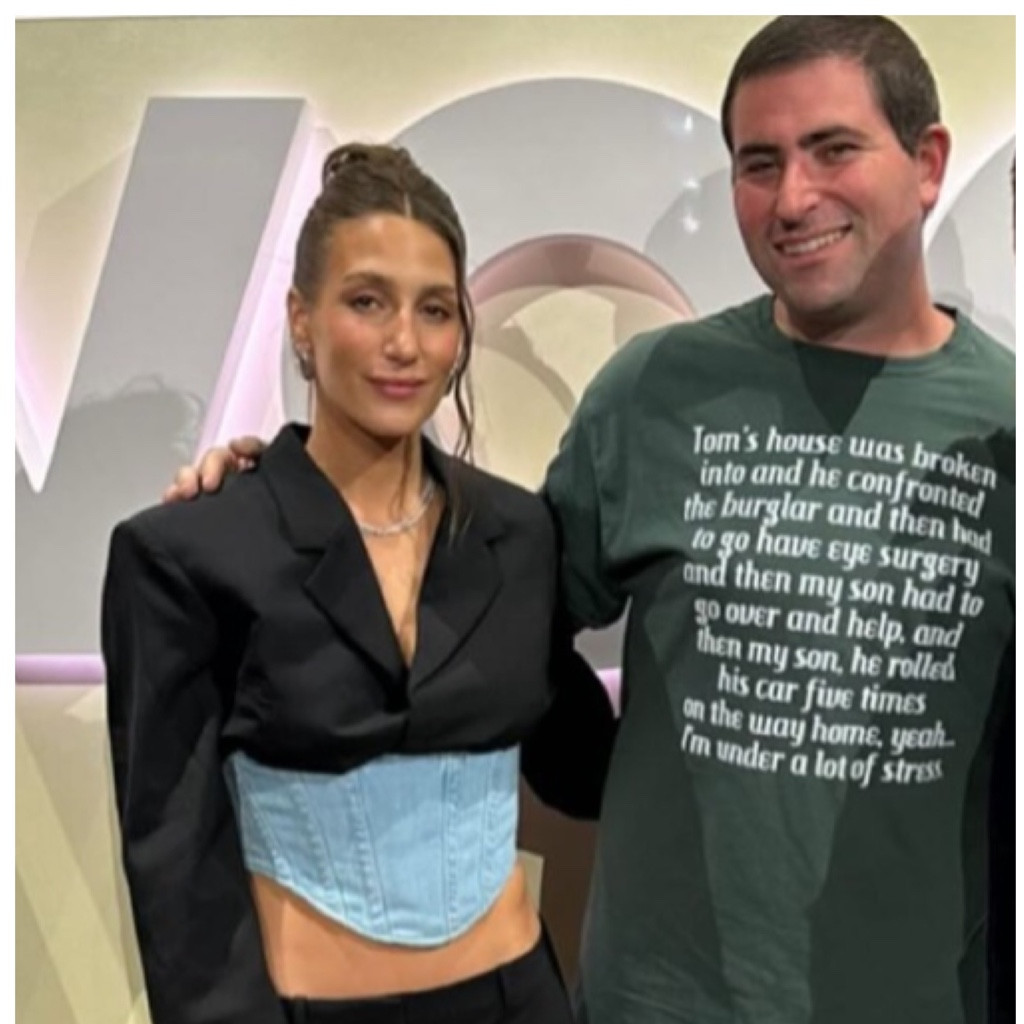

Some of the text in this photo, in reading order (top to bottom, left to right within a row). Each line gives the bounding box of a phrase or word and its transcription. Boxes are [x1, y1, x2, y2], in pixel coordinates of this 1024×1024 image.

[693, 425, 996, 490] Tom's house was broken
[701, 458, 985, 519] into and he confronted
[683, 491, 992, 555] the burglar and then had
[683, 556, 984, 617] and then my son had to
[692, 525, 980, 588] to go have eye surgery
[694, 598, 720, 625] go
[725, 603, 780, 629] over
[787, 607, 840, 635] and
[914, 620, 964, 648] and
[697, 625, 955, 681] then my son, he rolled
[718, 663, 927, 715] his car five times
[683, 698, 705, 721] on
[711, 698, 742, 730] the
[750, 713, 806, 747] way
[812, 715, 883, 748] home,
[681, 724, 943, 789] I'm under a lot of stress
